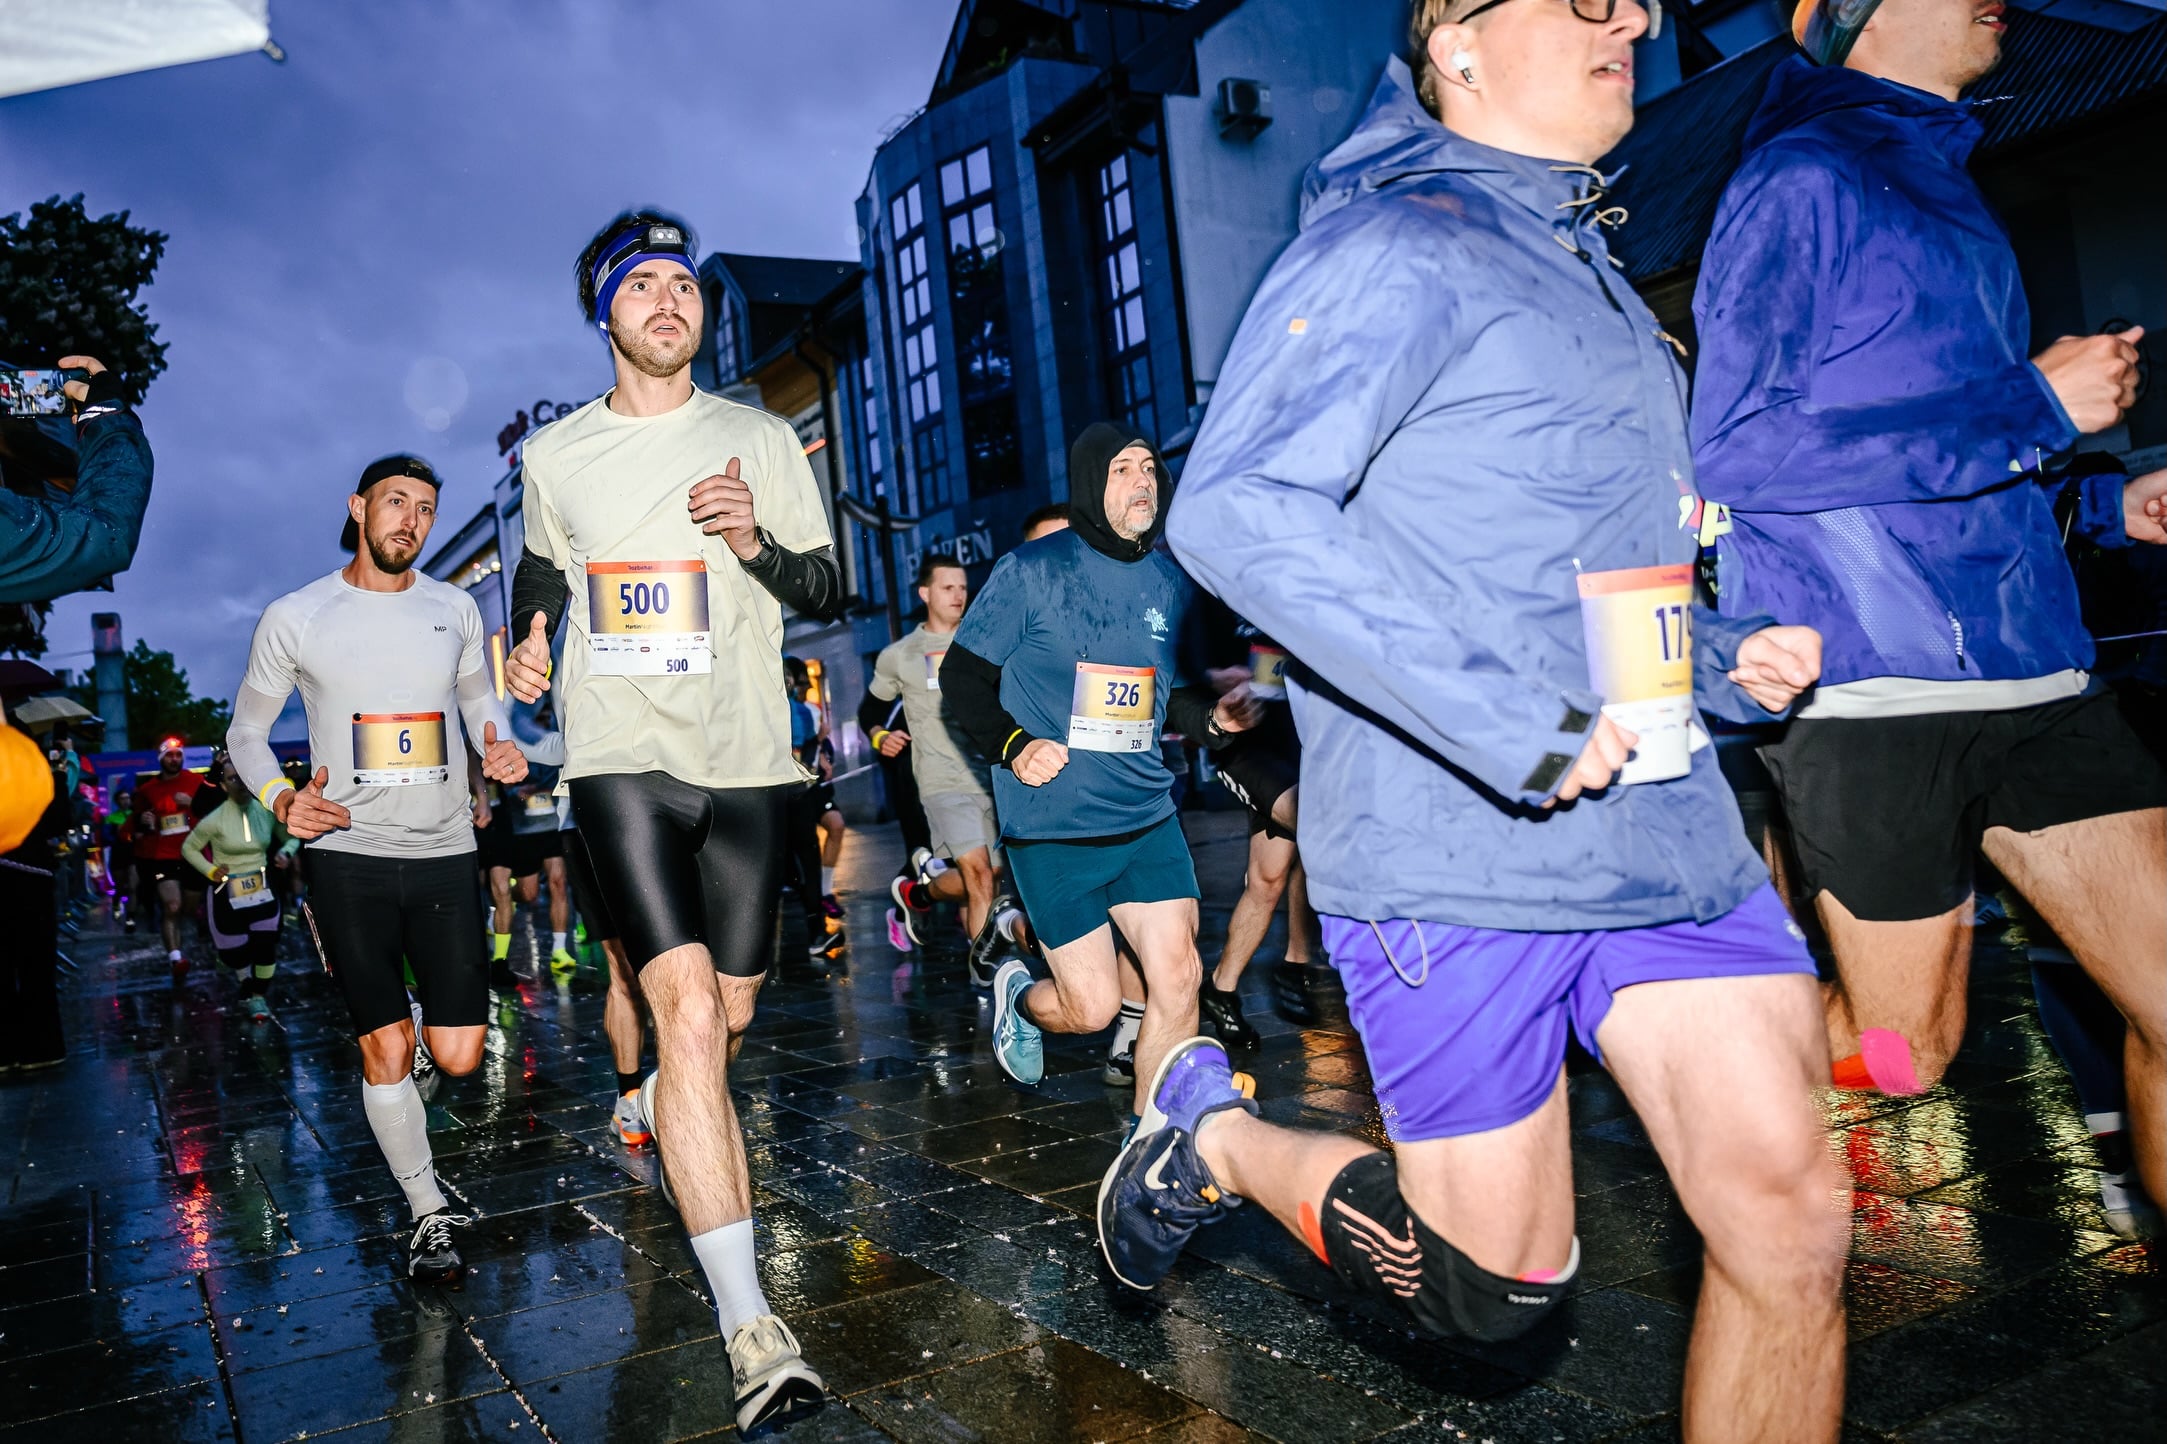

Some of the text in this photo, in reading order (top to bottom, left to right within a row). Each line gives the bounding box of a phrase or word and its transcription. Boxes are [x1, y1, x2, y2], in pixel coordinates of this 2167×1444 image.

[619, 582, 670, 615] 500
[666, 658, 688, 672] 500
[1105, 681, 1140, 707] 326
[398, 729, 412, 754] 6
[1130, 739, 1143, 750] 326
